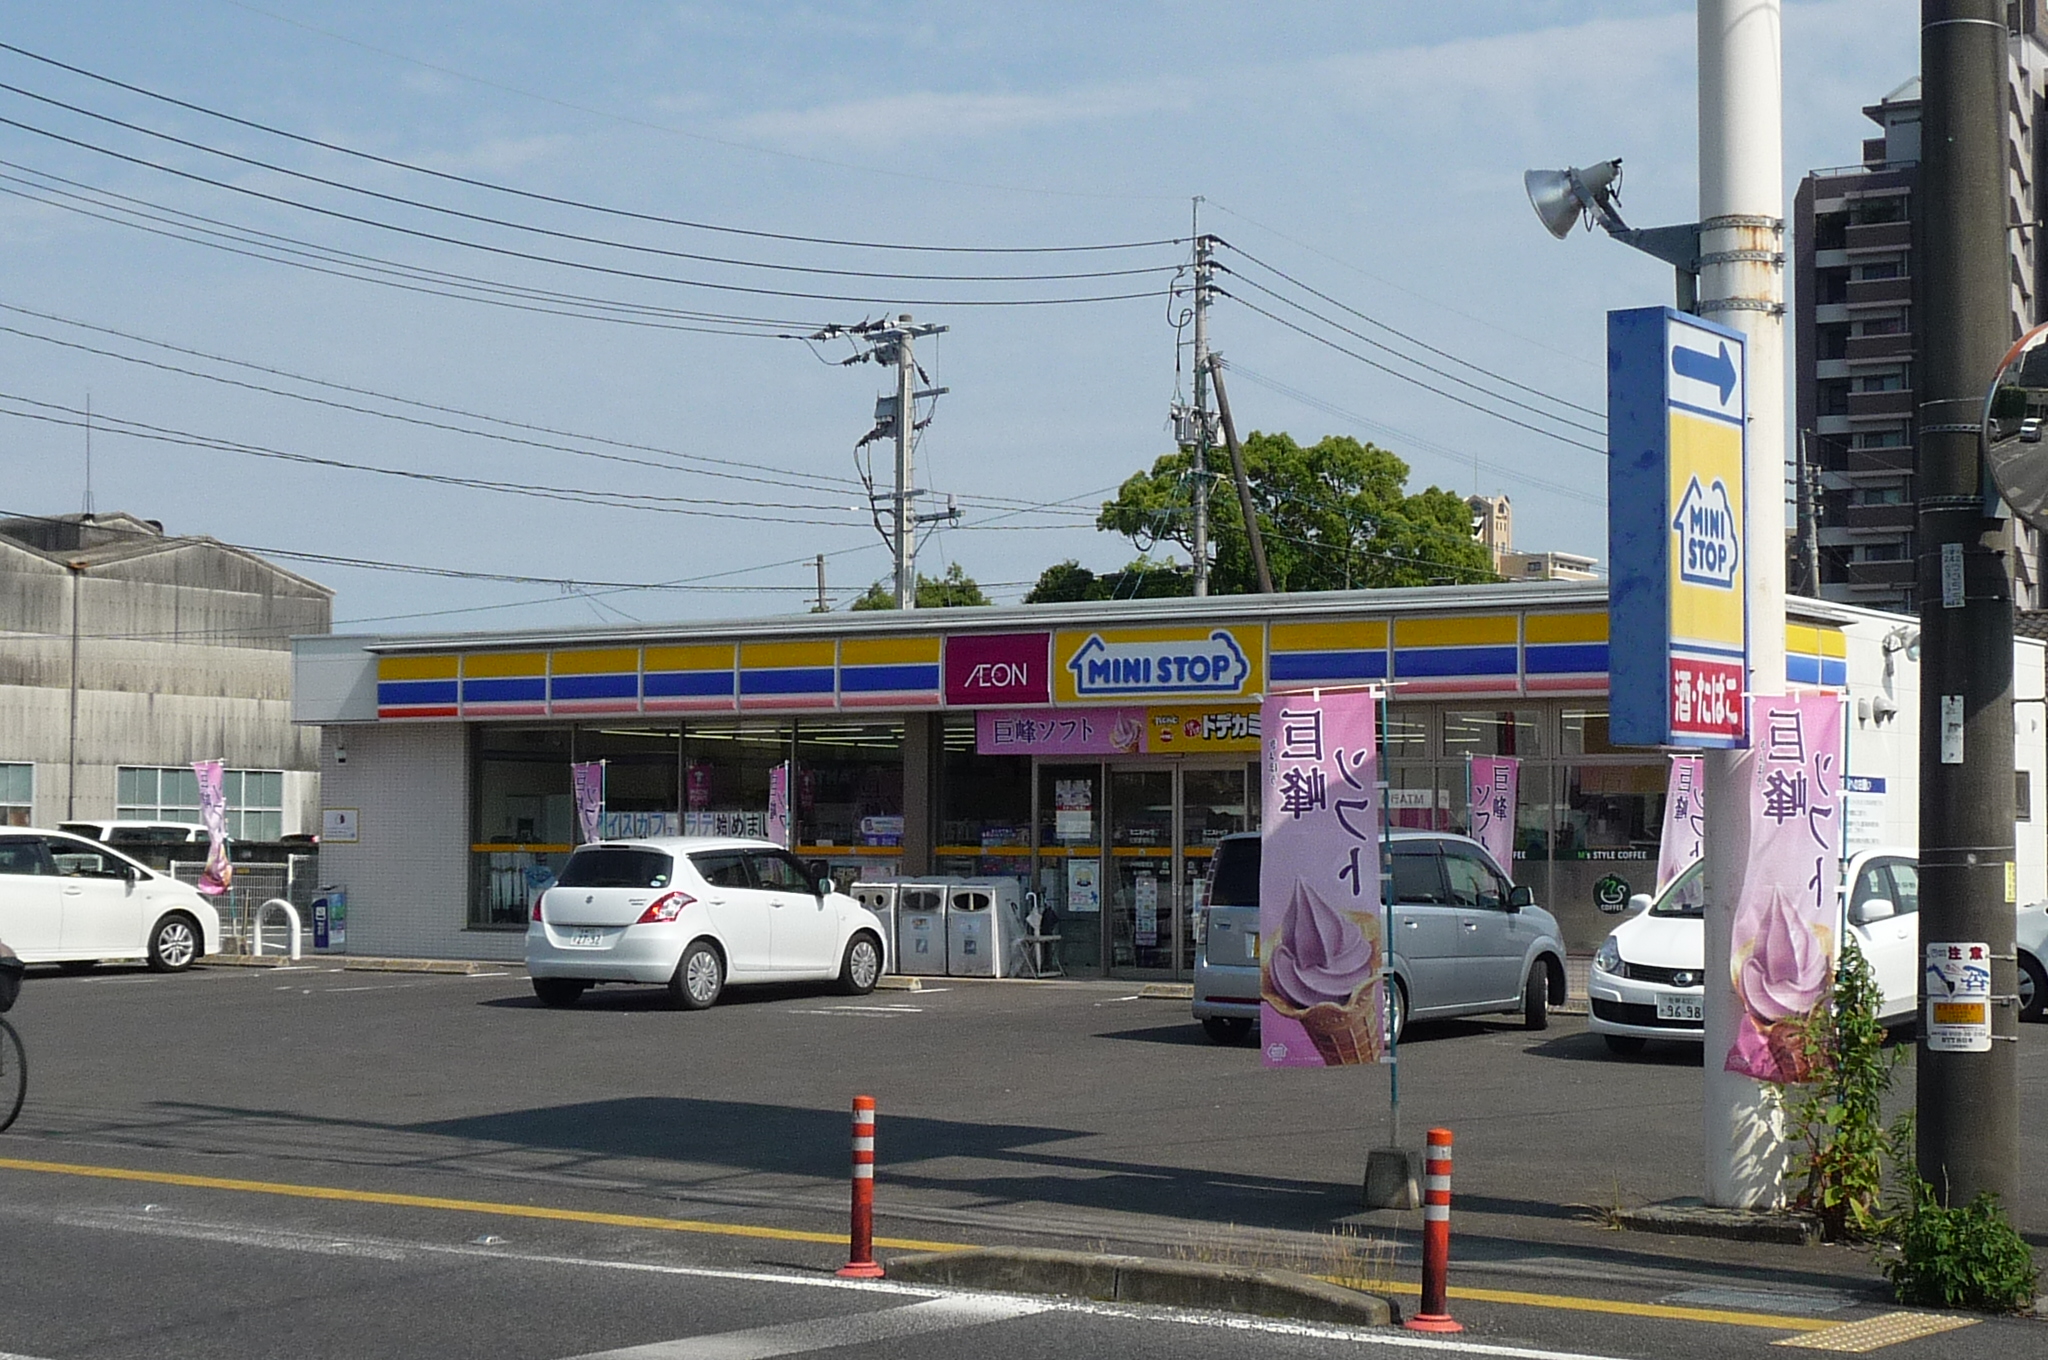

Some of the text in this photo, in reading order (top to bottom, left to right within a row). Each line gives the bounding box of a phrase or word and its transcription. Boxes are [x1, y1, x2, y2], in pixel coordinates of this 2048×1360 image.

[1689, 503, 1726, 537] MINI
[1688, 539, 1727, 573] STOP
[1088, 654, 1231, 685] MINI STOP
[993, 717, 1094, 746] 巨峰ソフト
[1492, 766, 1509, 822] 巨峰
[1593, 850, 1616, 860] STYLE
[1617, 850, 1647, 860] COFFEE
